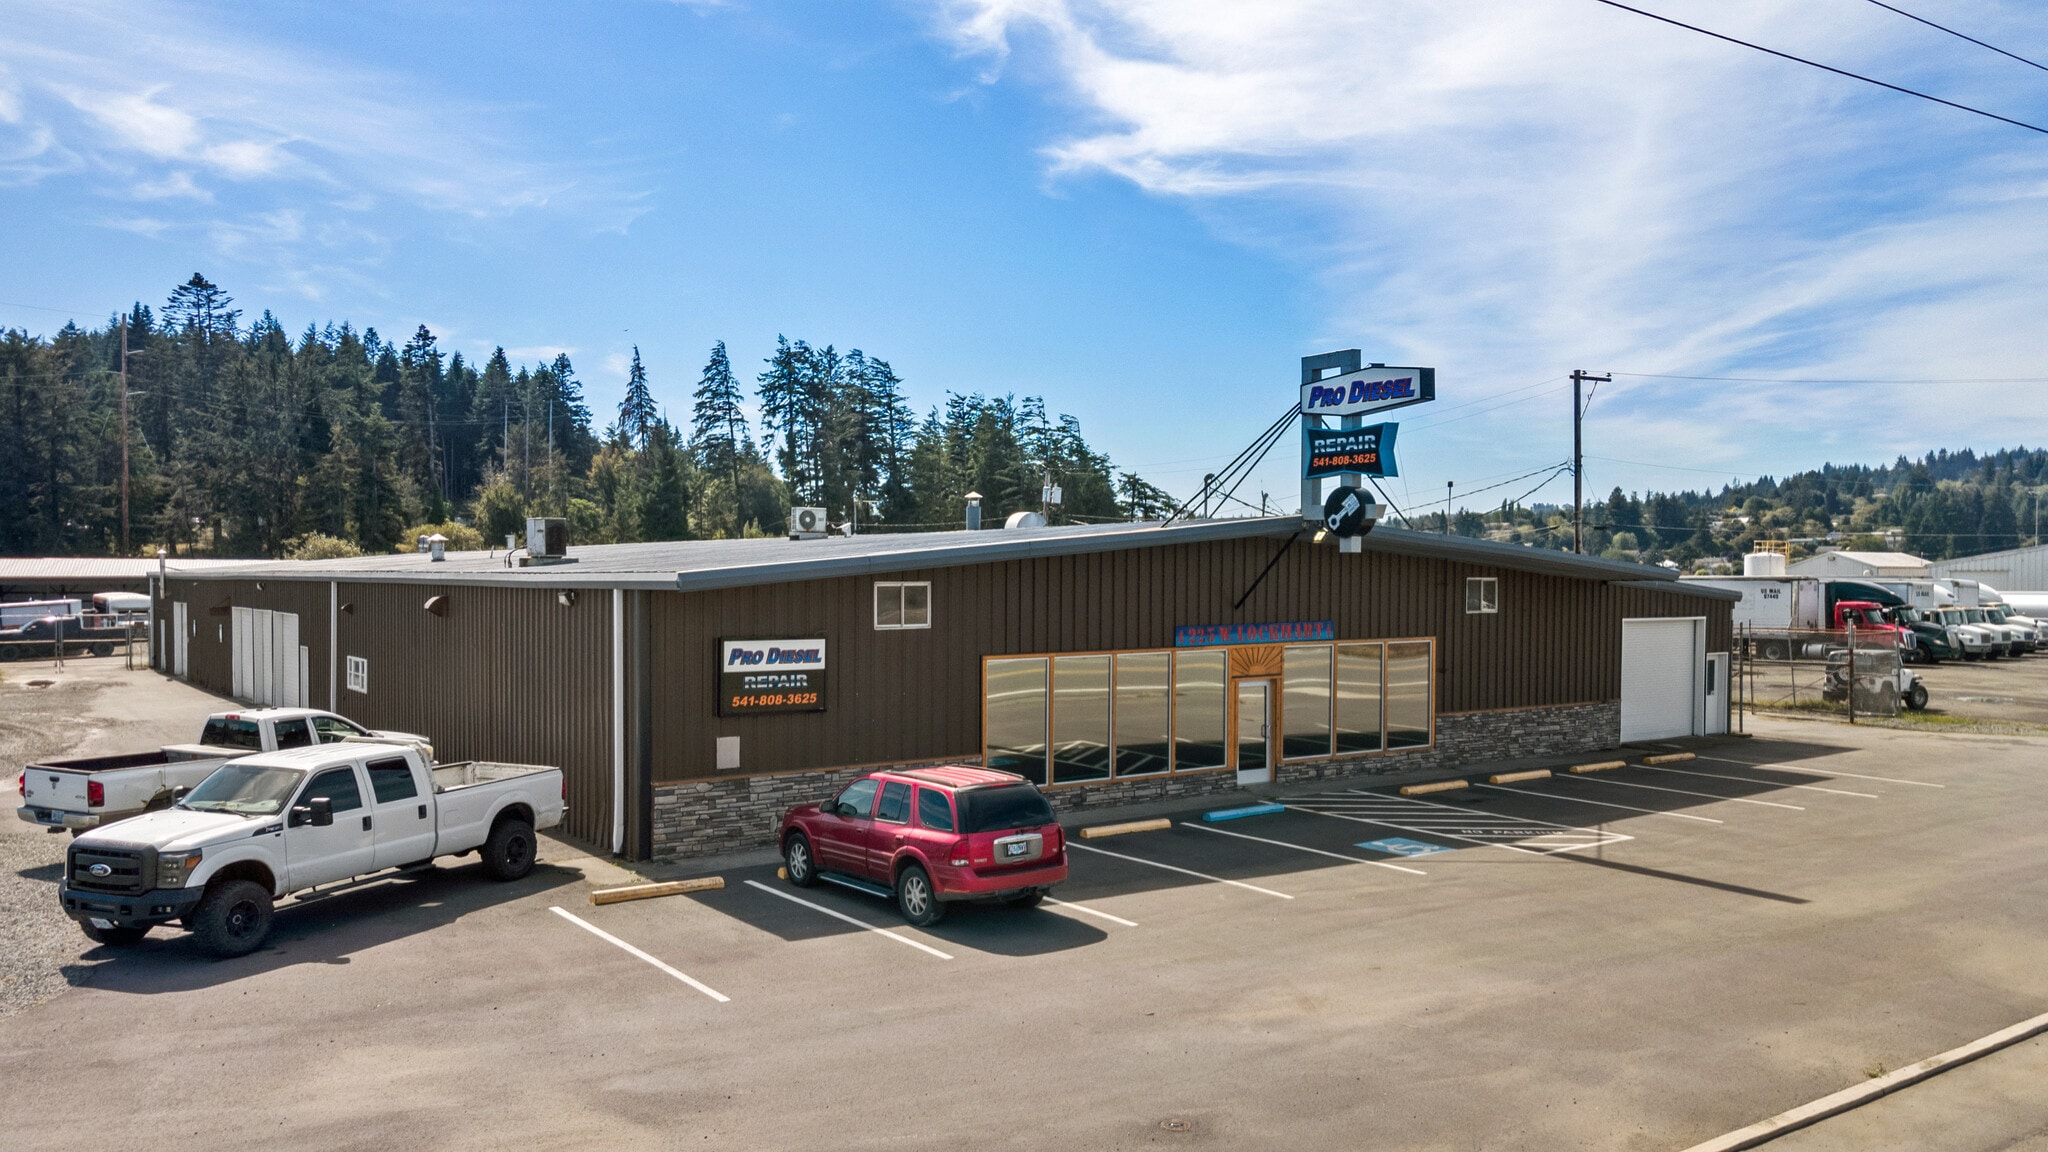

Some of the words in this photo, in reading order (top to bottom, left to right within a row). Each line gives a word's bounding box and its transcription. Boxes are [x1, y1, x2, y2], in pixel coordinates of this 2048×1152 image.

[1308, 385, 1346, 409] PRO
[1348, 377, 1416, 404] DIESEL
[1314, 435, 1377, 454] REPAIR
[1313, 453, 1376, 468] 541-808-3625
[728, 648, 764, 665] PRO
[766, 647, 822, 664] DIESEL
[744, 674, 808, 689] REPAIR
[732, 693, 817, 707] 541-808-3625
